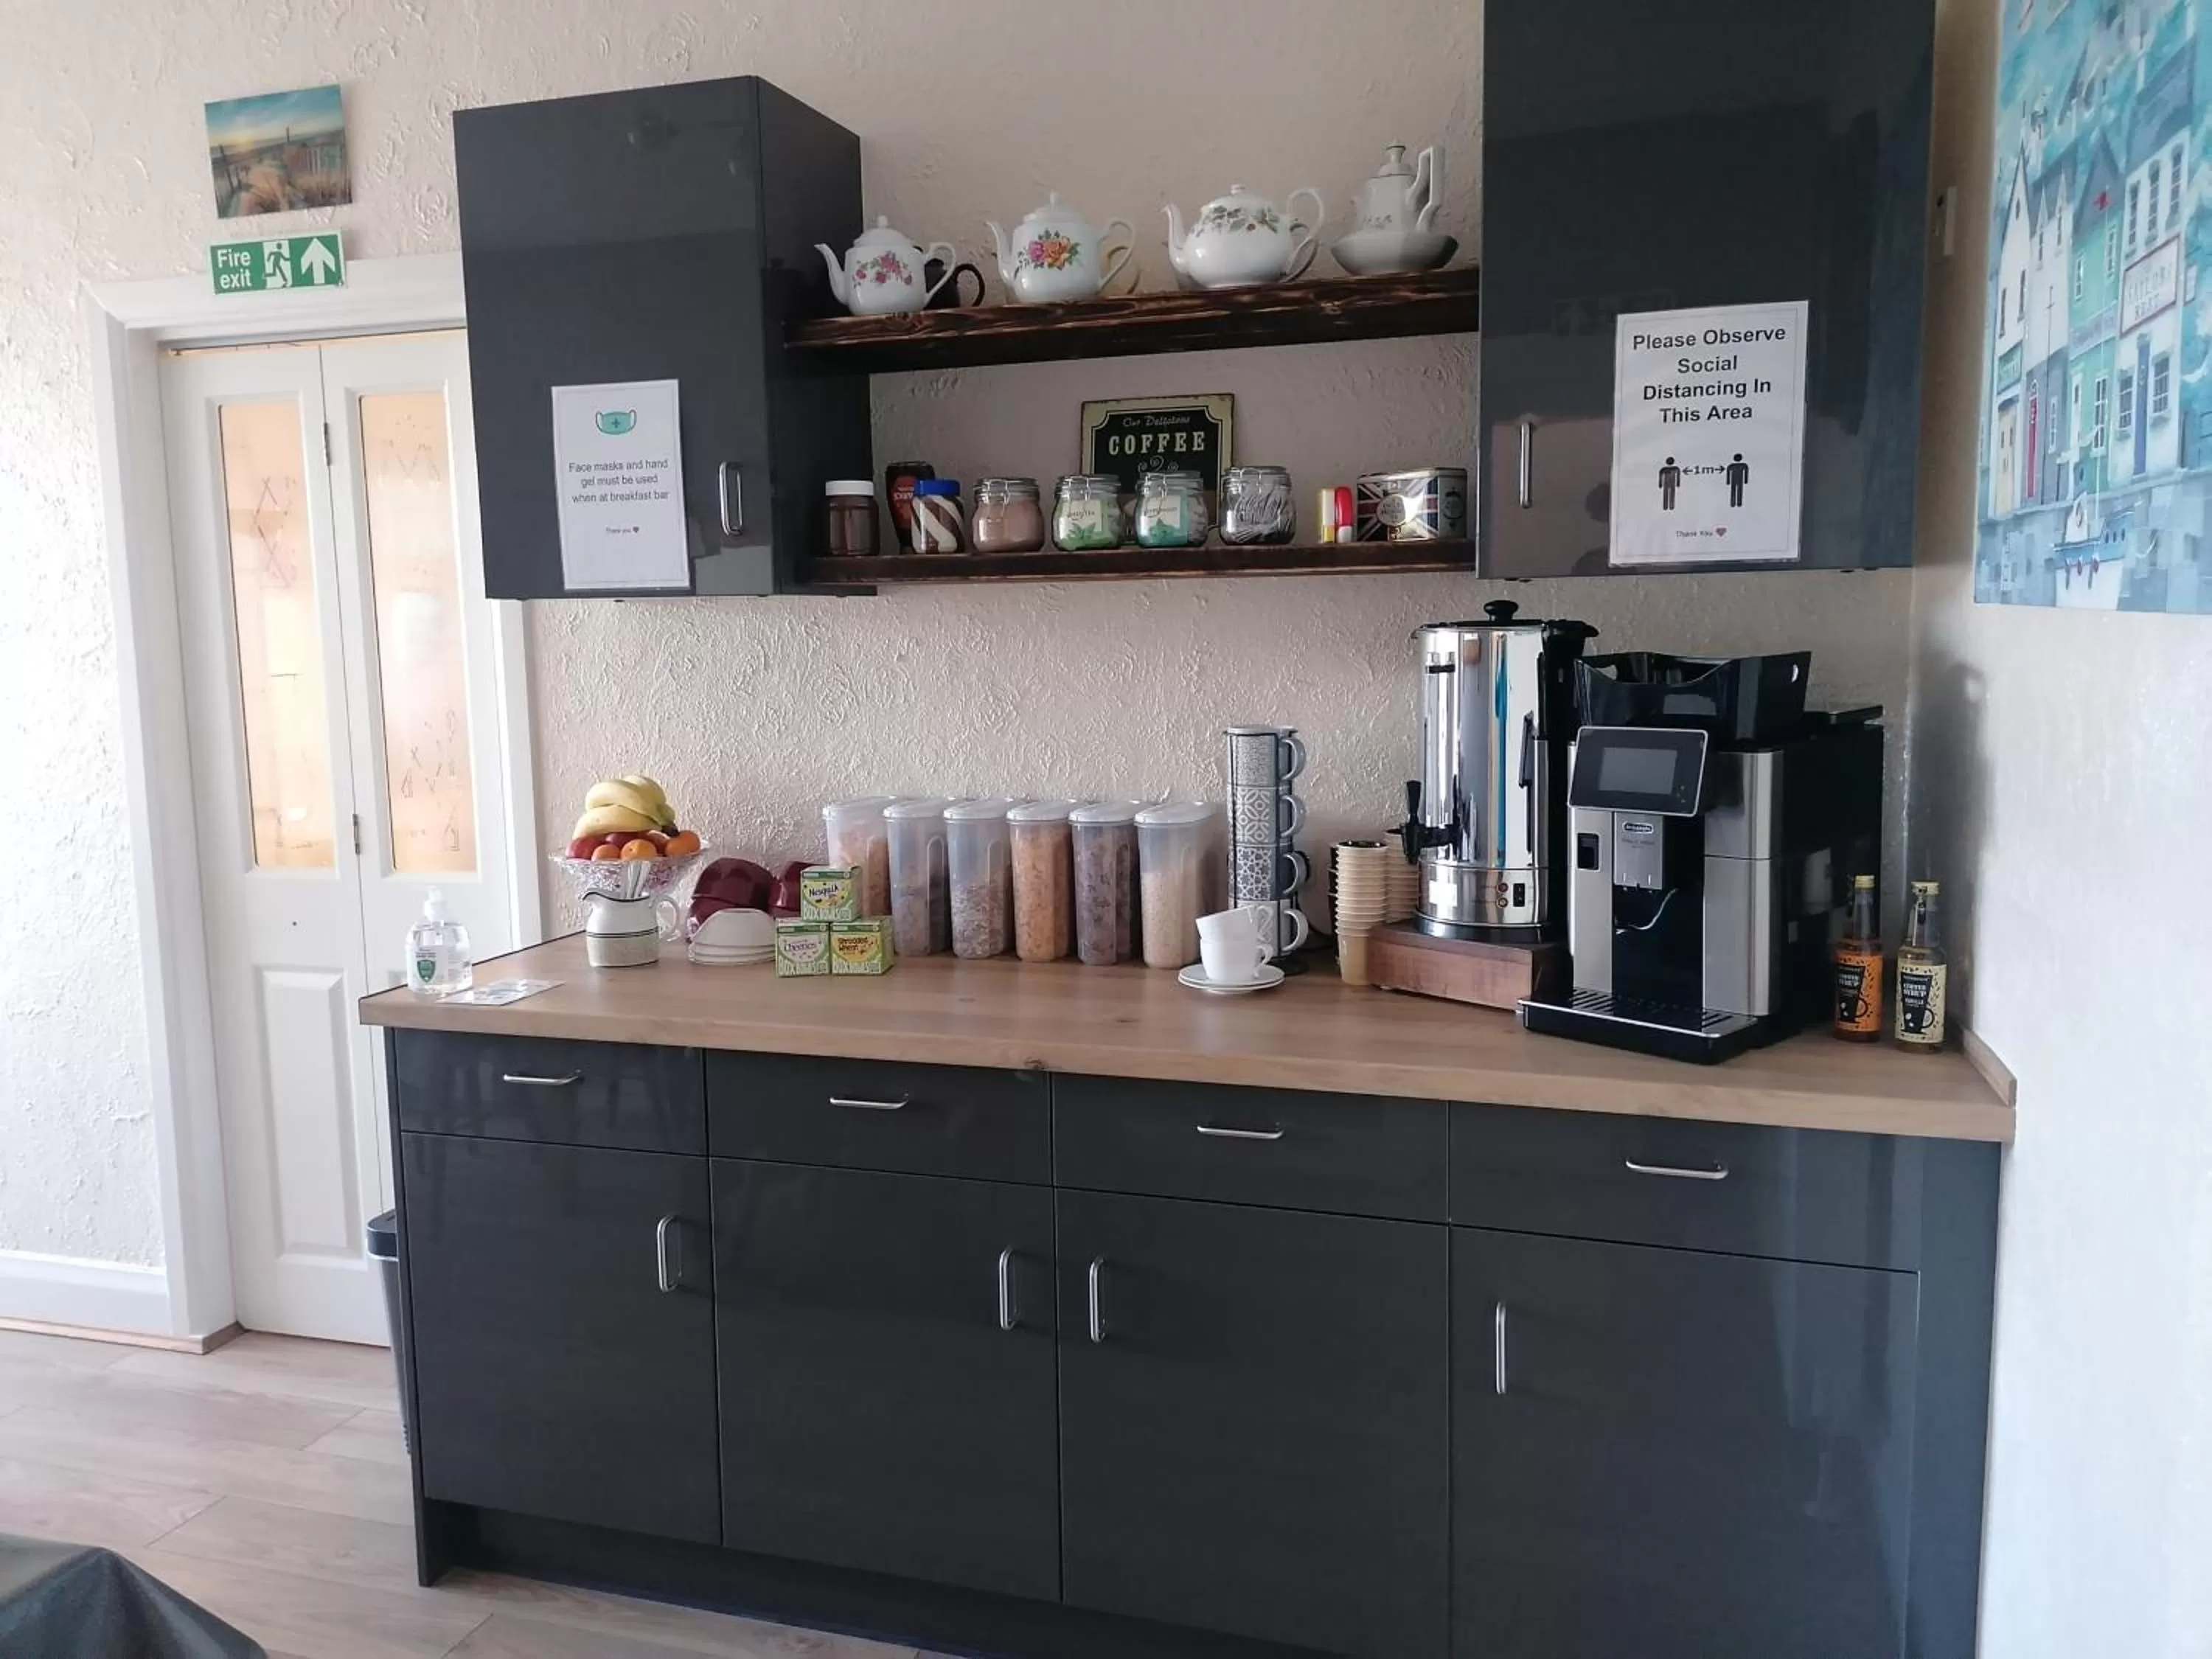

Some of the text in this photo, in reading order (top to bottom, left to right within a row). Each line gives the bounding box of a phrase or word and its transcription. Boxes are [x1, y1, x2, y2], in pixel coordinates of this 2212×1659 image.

[218, 248, 251, 268] Fire
[220, 268, 252, 288] exit
[1632, 327, 1786, 350] Please Observe
[1677, 355, 1738, 373] Social
[1643, 378, 1772, 400] Distancing In
[1659, 405, 1753, 423] This Area
[1108, 431, 1205, 456] COFFEE
[568, 459, 669, 473] Face masks and hand
[1693, 465, 1714, 476] 1m
[580, 473, 658, 489] gel must be used
[571, 489, 670, 503] when at breakfast bar
